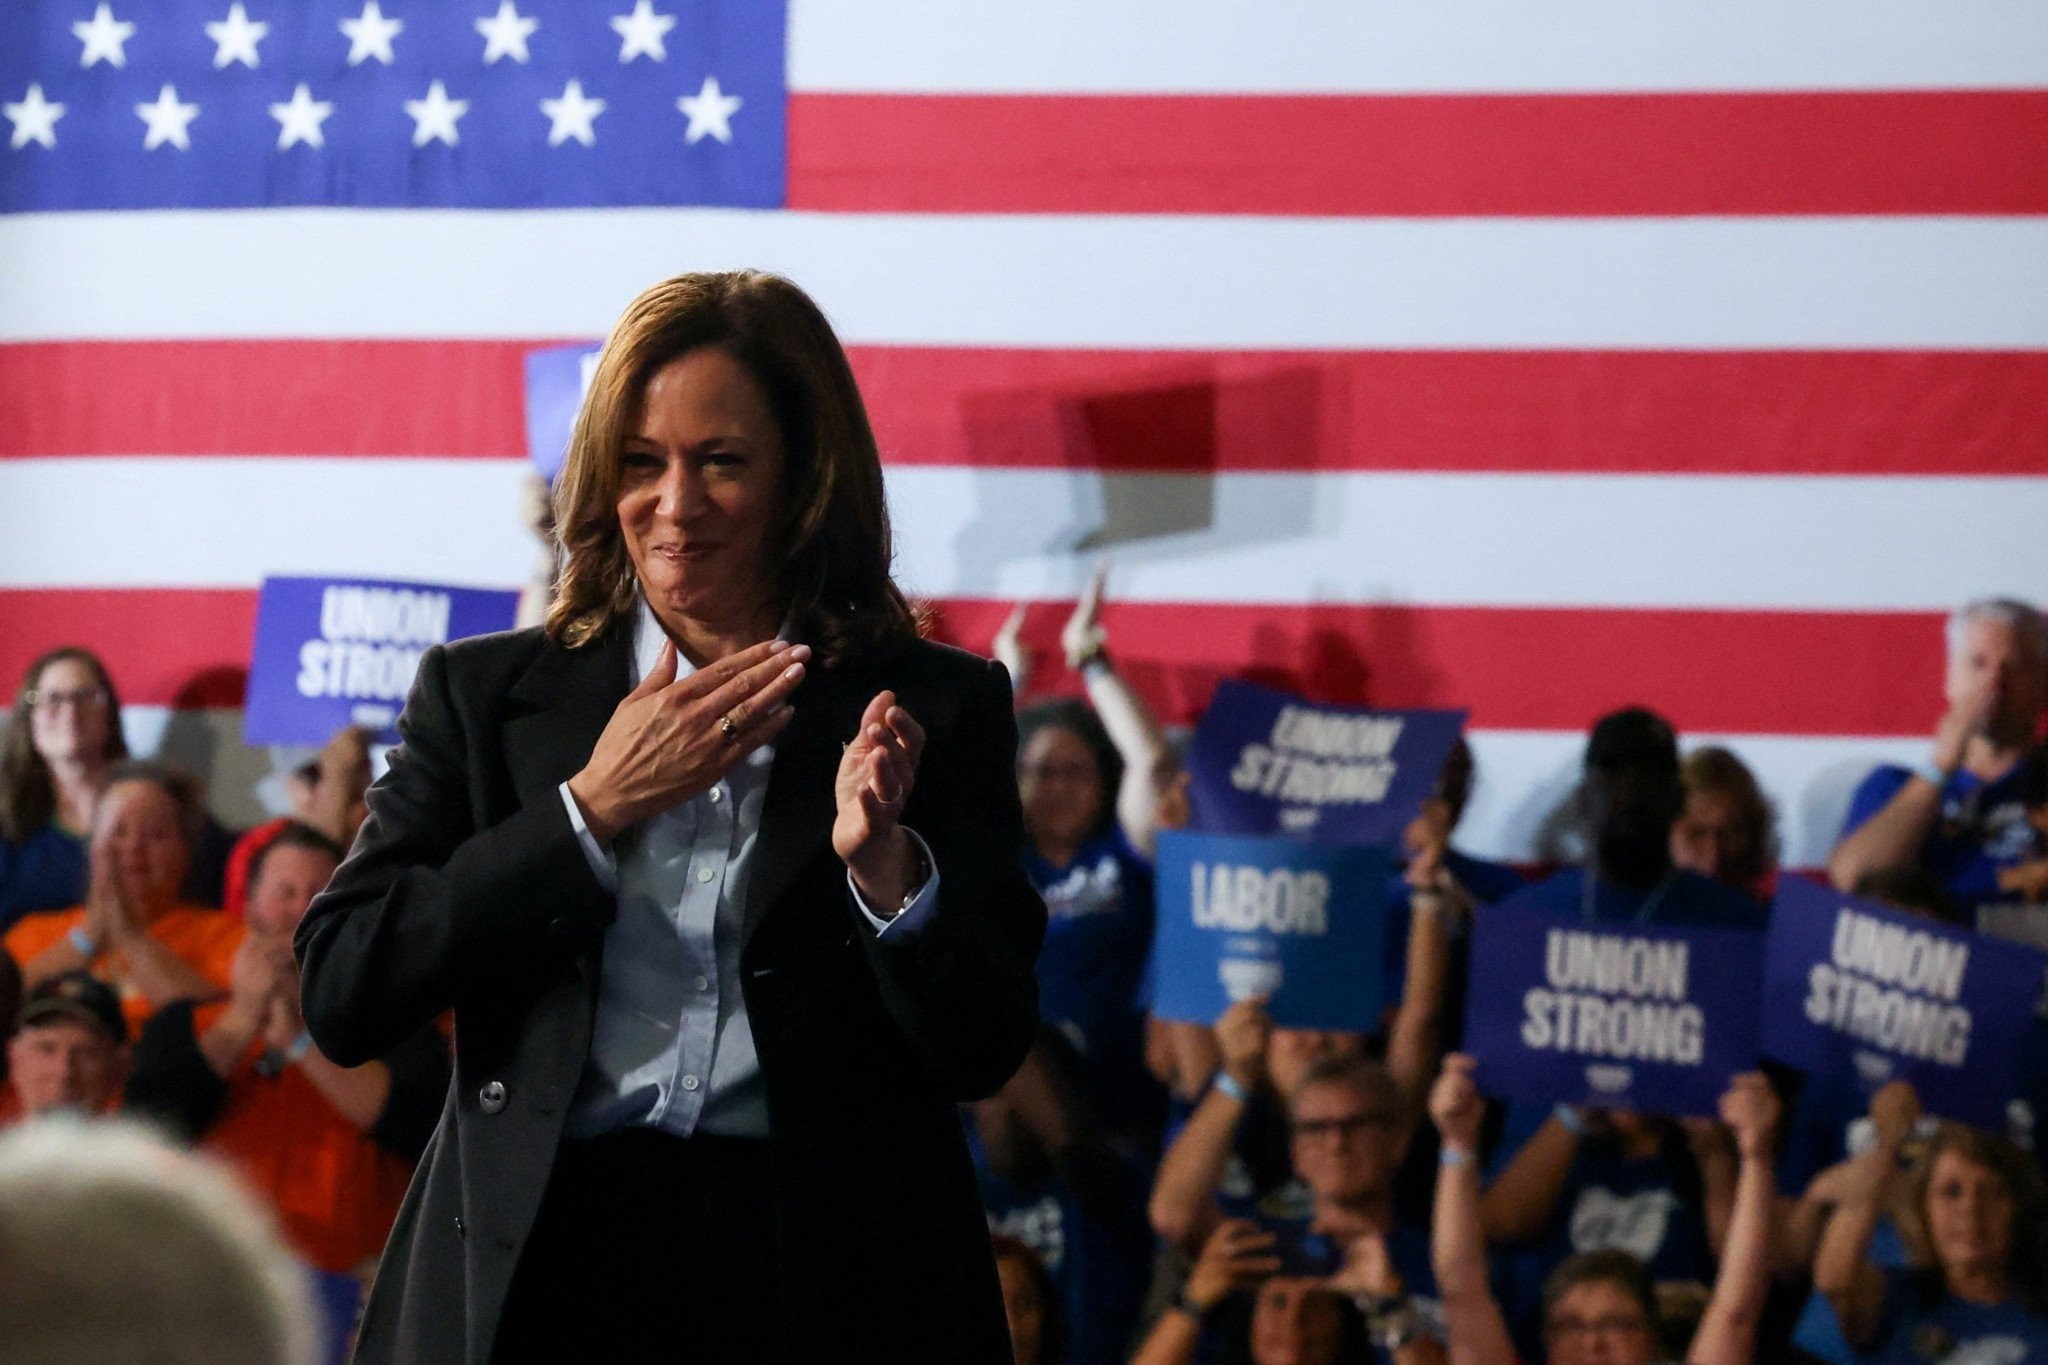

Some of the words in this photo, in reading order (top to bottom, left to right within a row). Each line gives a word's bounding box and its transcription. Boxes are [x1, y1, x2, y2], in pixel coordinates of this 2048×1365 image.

[321, 585, 450, 643] UNION
[297, 640, 424, 698] STRON
[1271, 704, 1404, 757] UNION
[1230, 743, 1398, 803] STRONG
[1191, 862, 1329, 935] LABOR
[1546, 928, 1689, 1000] UNION
[1833, 907, 1970, 1000] UNION
[1521, 987, 1704, 1065] STRONG
[1805, 963, 1972, 1067] STRONG
